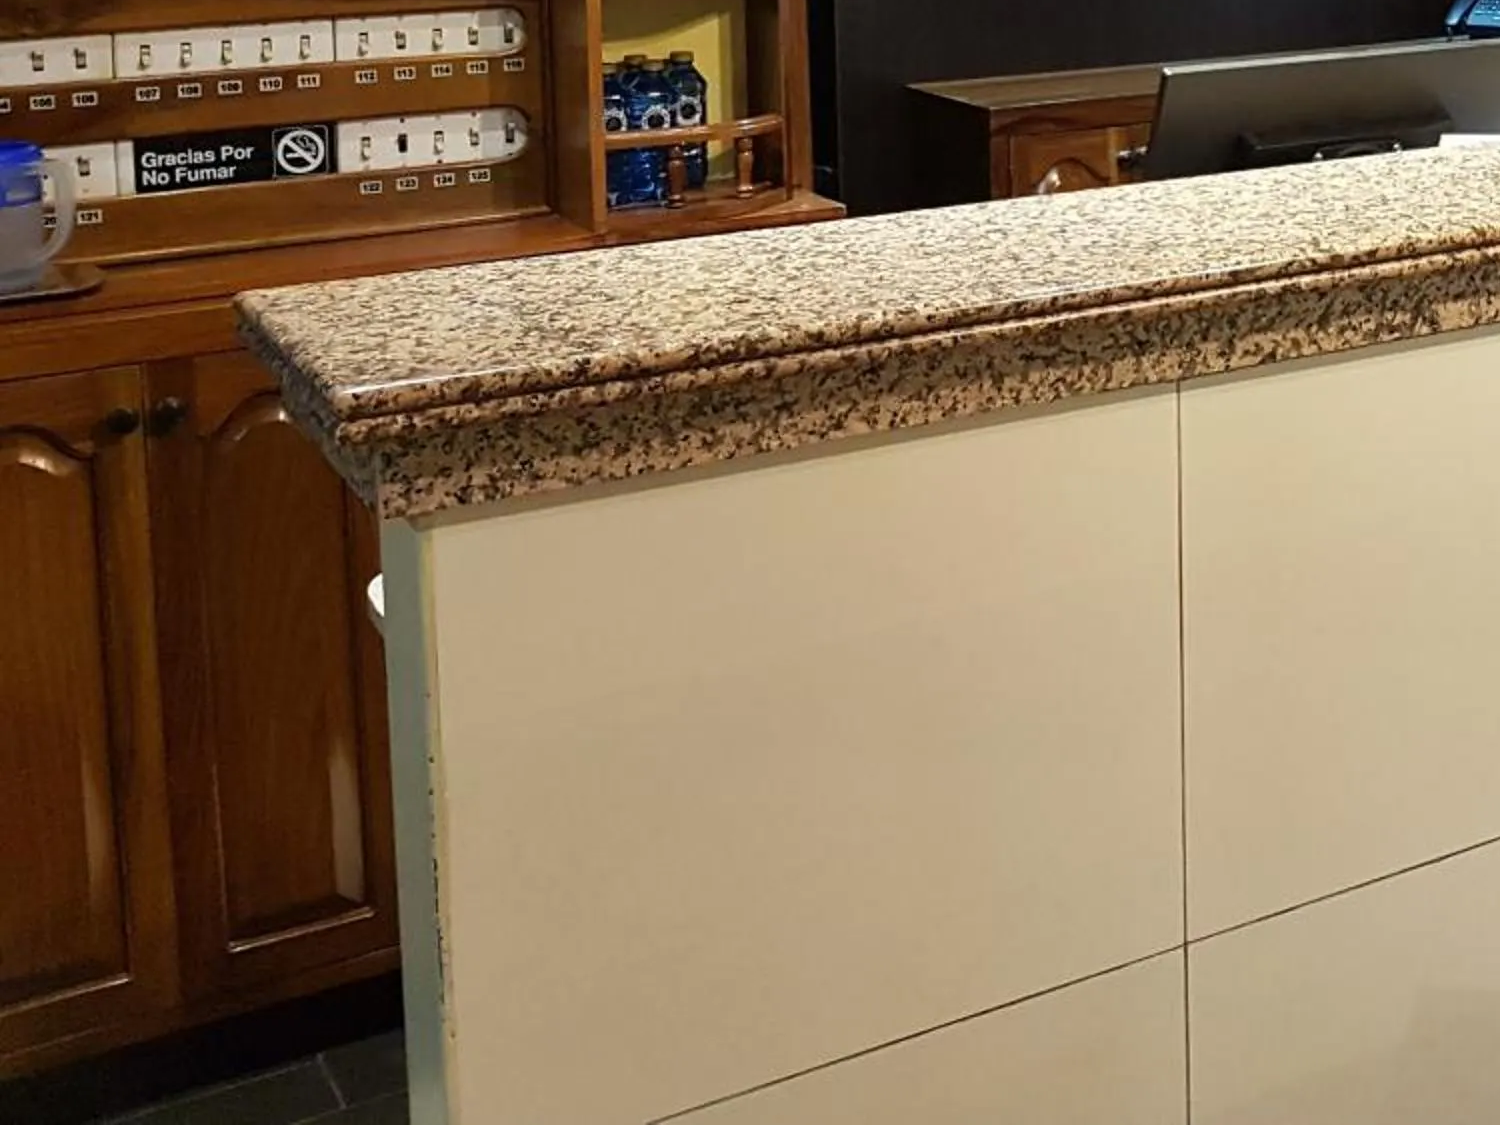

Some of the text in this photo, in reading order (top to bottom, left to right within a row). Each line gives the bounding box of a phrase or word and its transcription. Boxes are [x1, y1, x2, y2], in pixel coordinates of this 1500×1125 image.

[141, 146, 254, 168] Gracias Por
[142, 165, 237, 186] No Fumar
